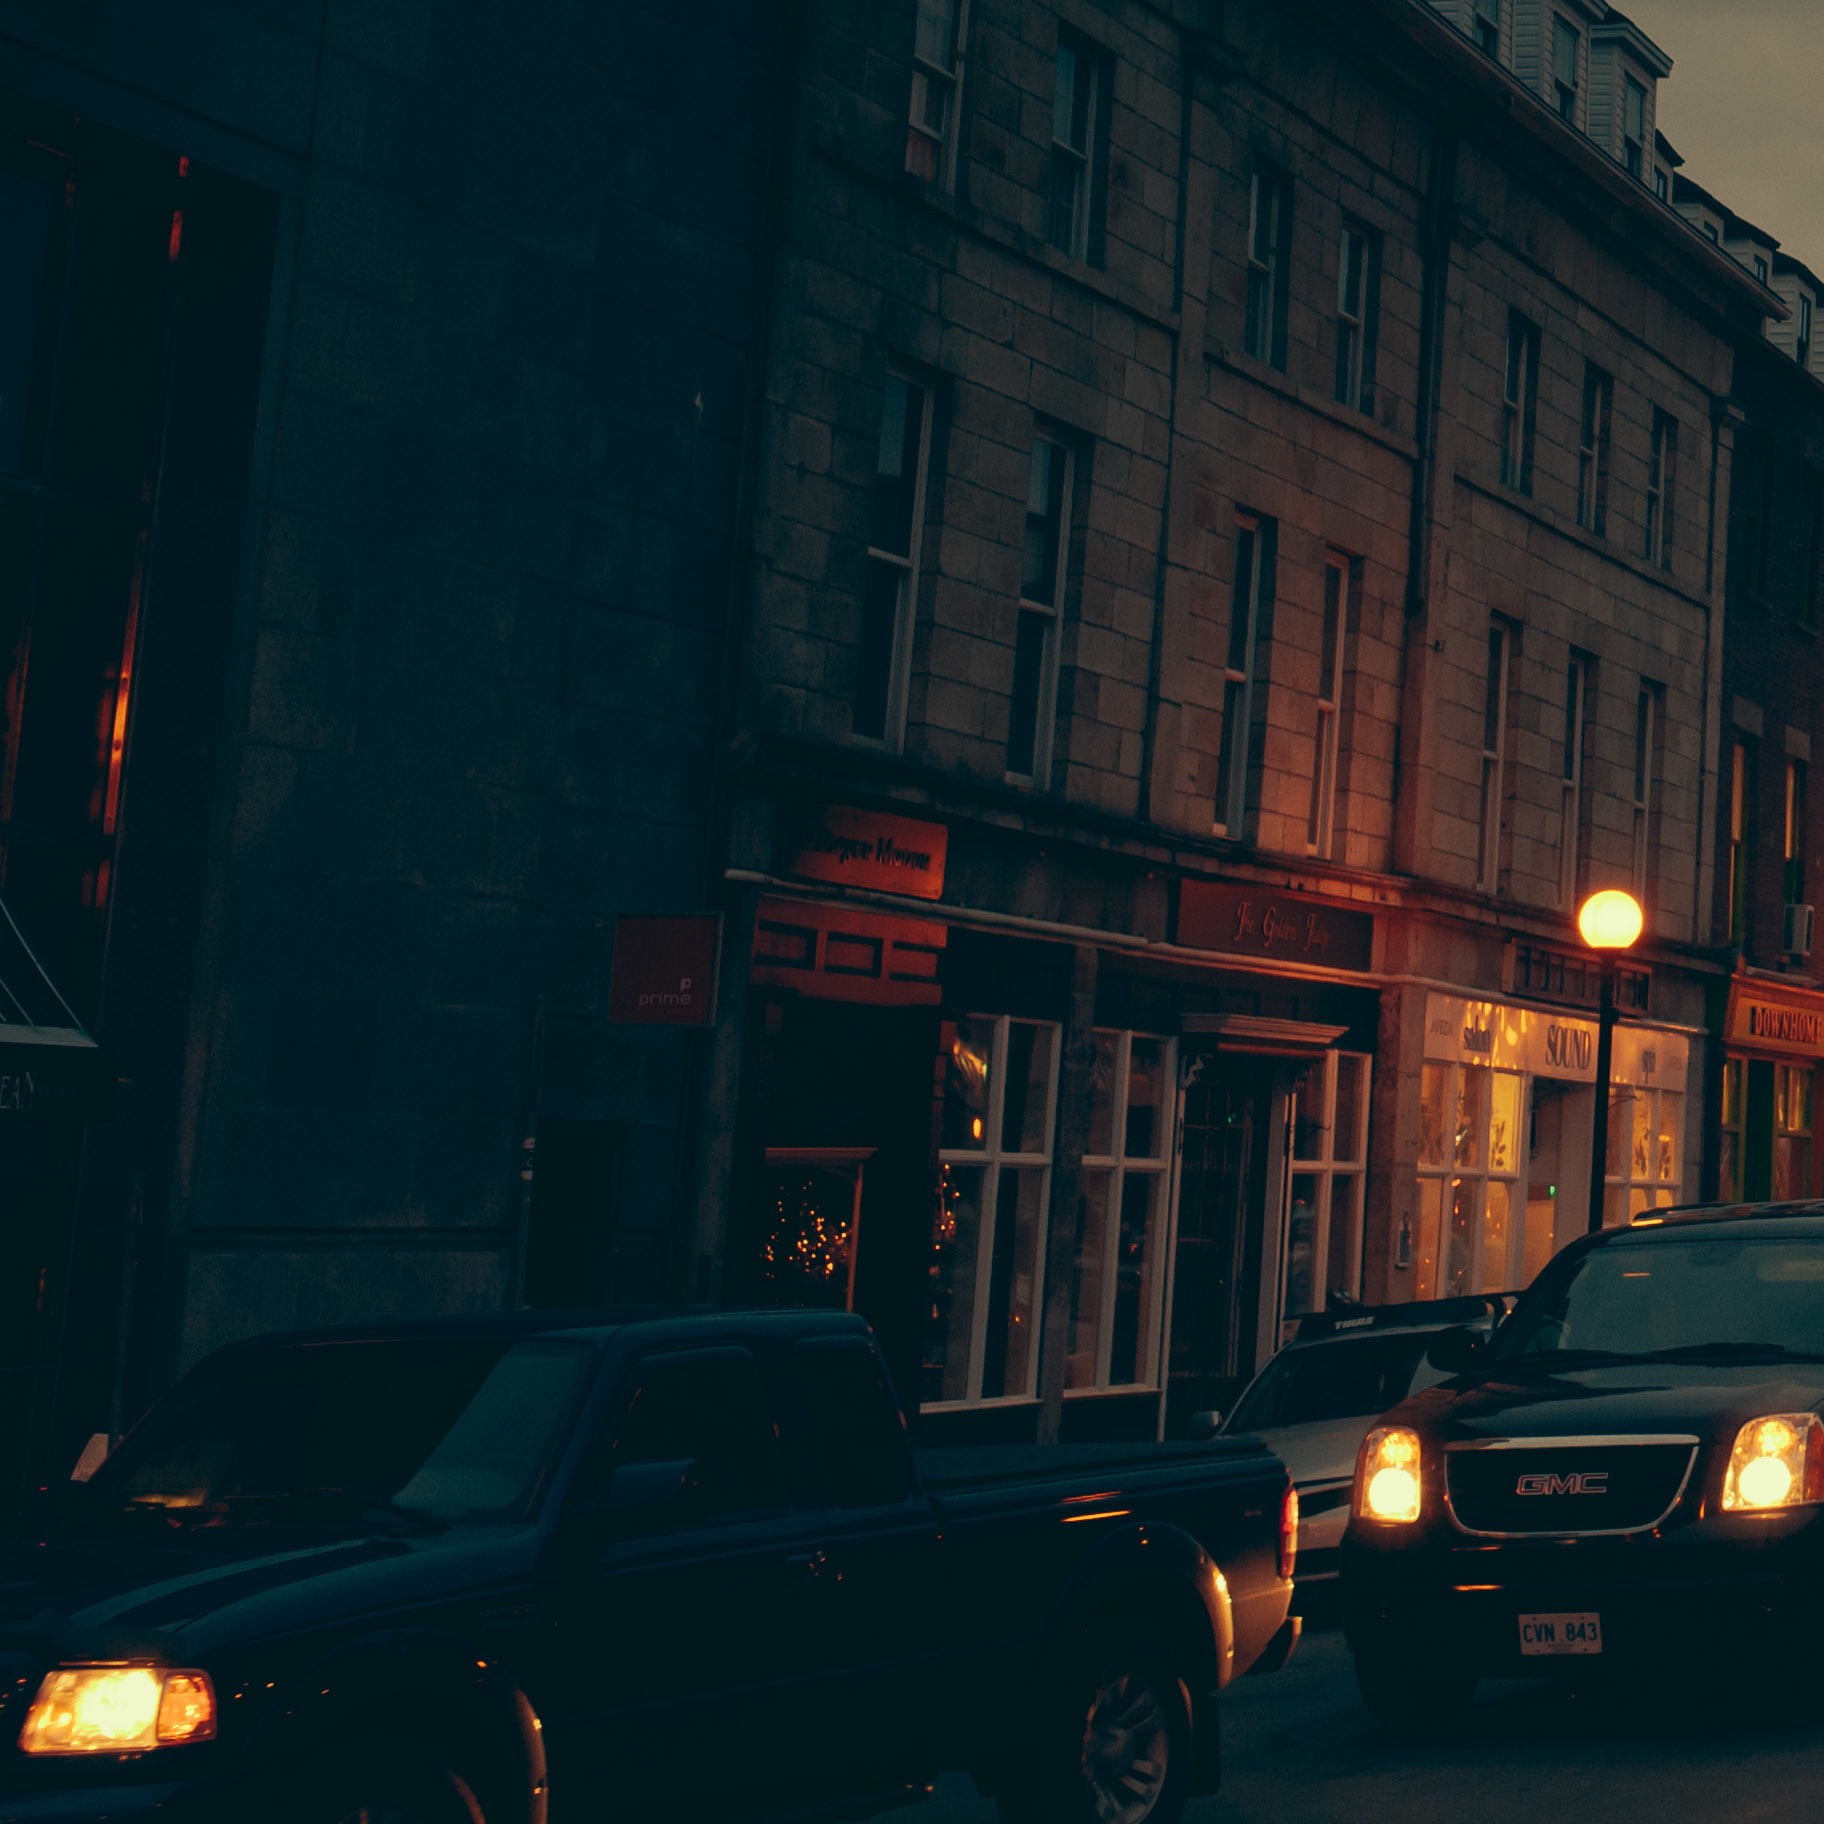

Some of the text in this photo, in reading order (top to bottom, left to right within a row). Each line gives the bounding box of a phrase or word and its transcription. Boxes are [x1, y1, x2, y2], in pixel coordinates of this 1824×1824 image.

[639, 992, 691, 1008] prime
[1751, 1006, 1821, 1044] DOWNHOME
[1546, 1024, 1592, 1070] SOUND
[1335, 1316, 1375, 1330] THULE
[1516, 1472, 1608, 1496] GMC
[1523, 1622, 1598, 1643] CVN 843
